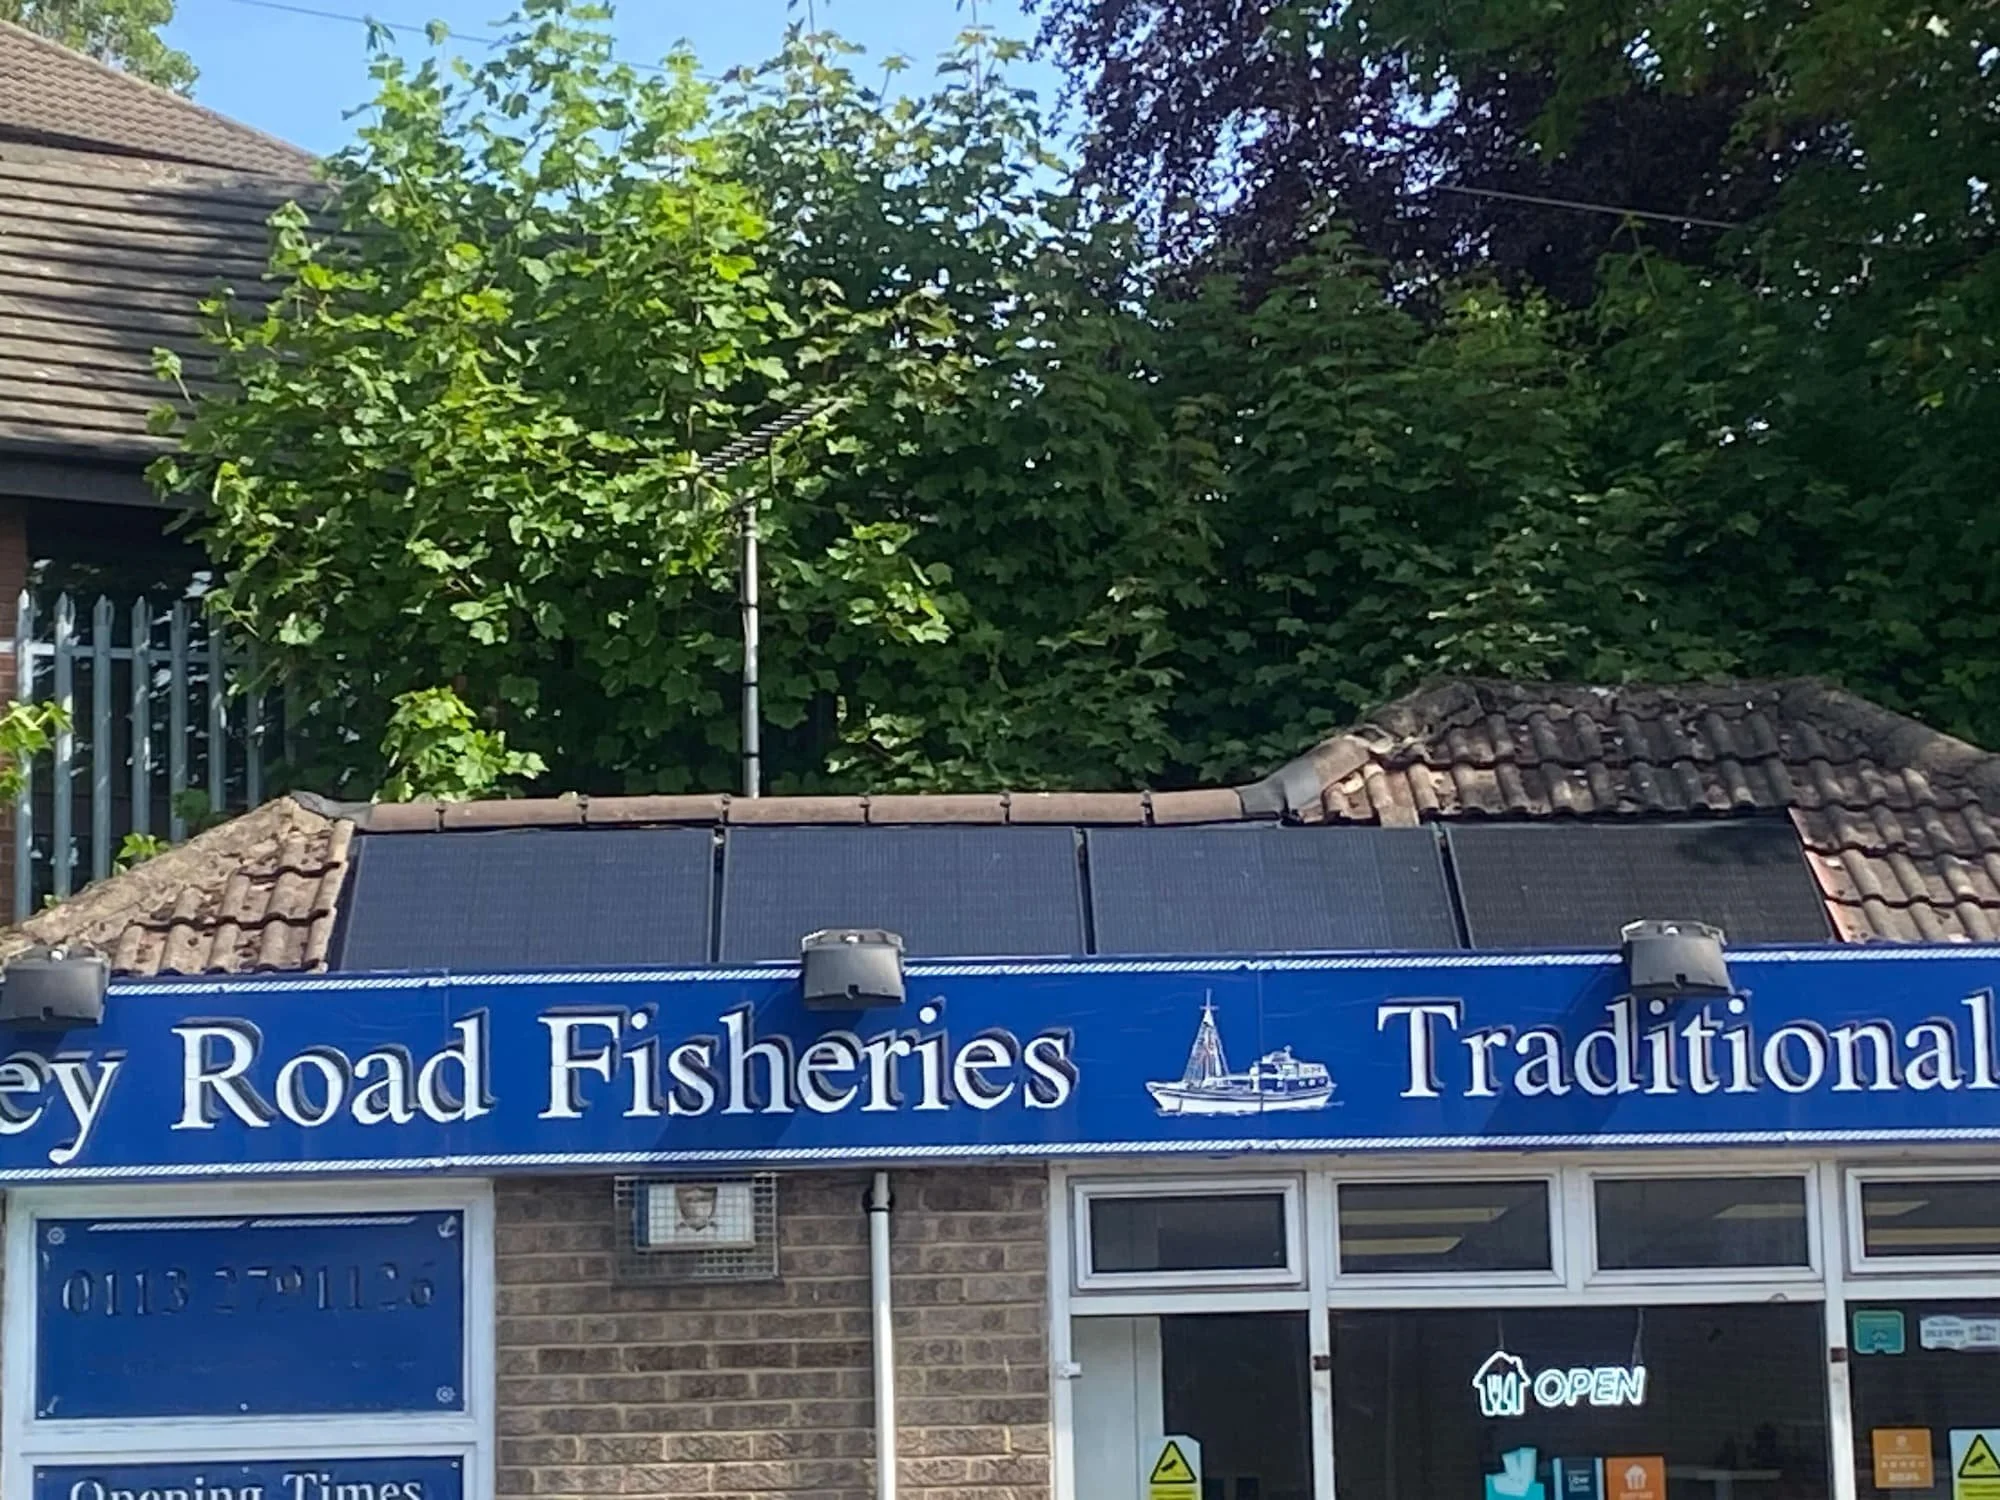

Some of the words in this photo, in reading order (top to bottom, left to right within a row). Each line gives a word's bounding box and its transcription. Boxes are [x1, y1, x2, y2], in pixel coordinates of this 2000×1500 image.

[171, 1009, 495, 1130] Road
[538, 1001, 1078, 1119] Fisheries
[1377, 991, 2000, 1099] Traditional
[61, 1265, 190, 1317] 0113
[1534, 1366, 1646, 1407] OPEN
[282, 1473, 422, 1500] Times
